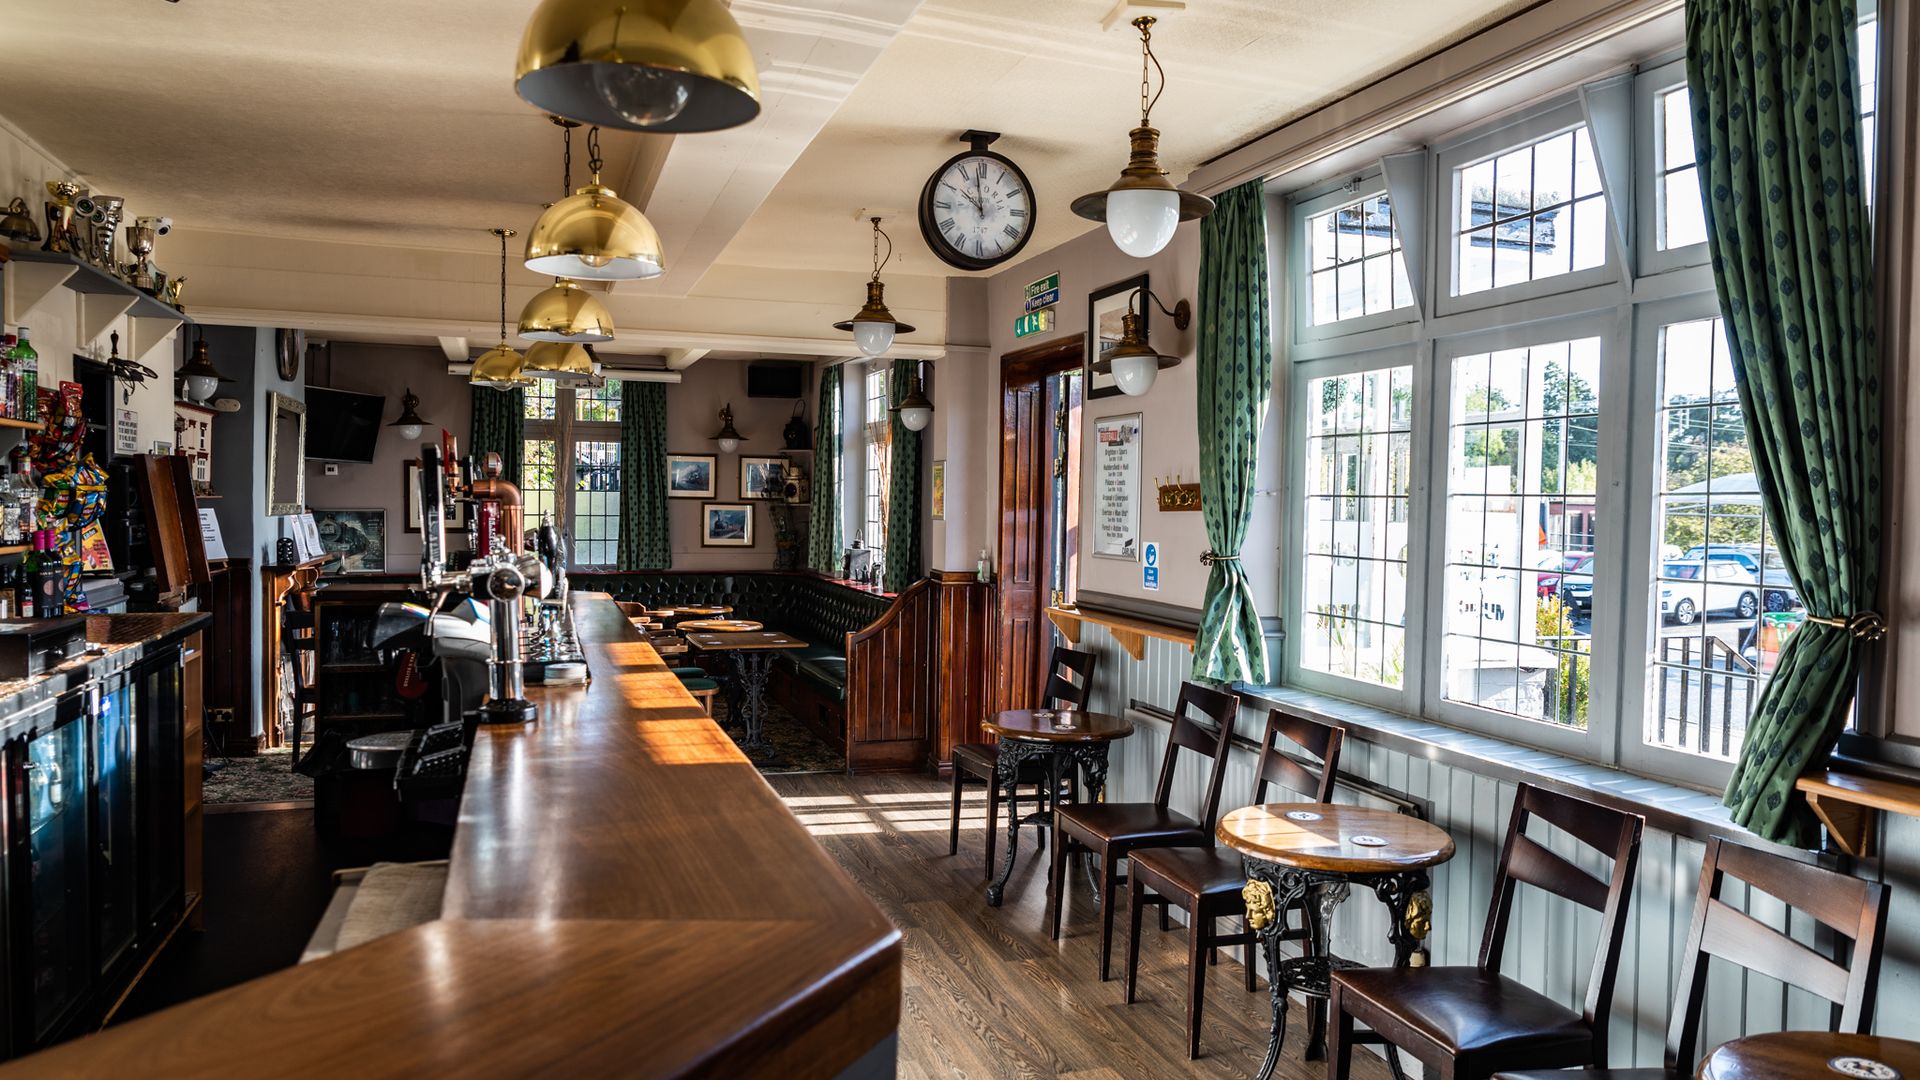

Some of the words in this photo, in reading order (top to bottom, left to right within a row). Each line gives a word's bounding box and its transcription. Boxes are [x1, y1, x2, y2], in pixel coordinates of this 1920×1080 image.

[1031, 285, 1040, 296] Fire
[1040, 280, 1050, 292] exit
[1031, 298, 1042, 309] Keep
[1043, 292, 1055, 304] clear
